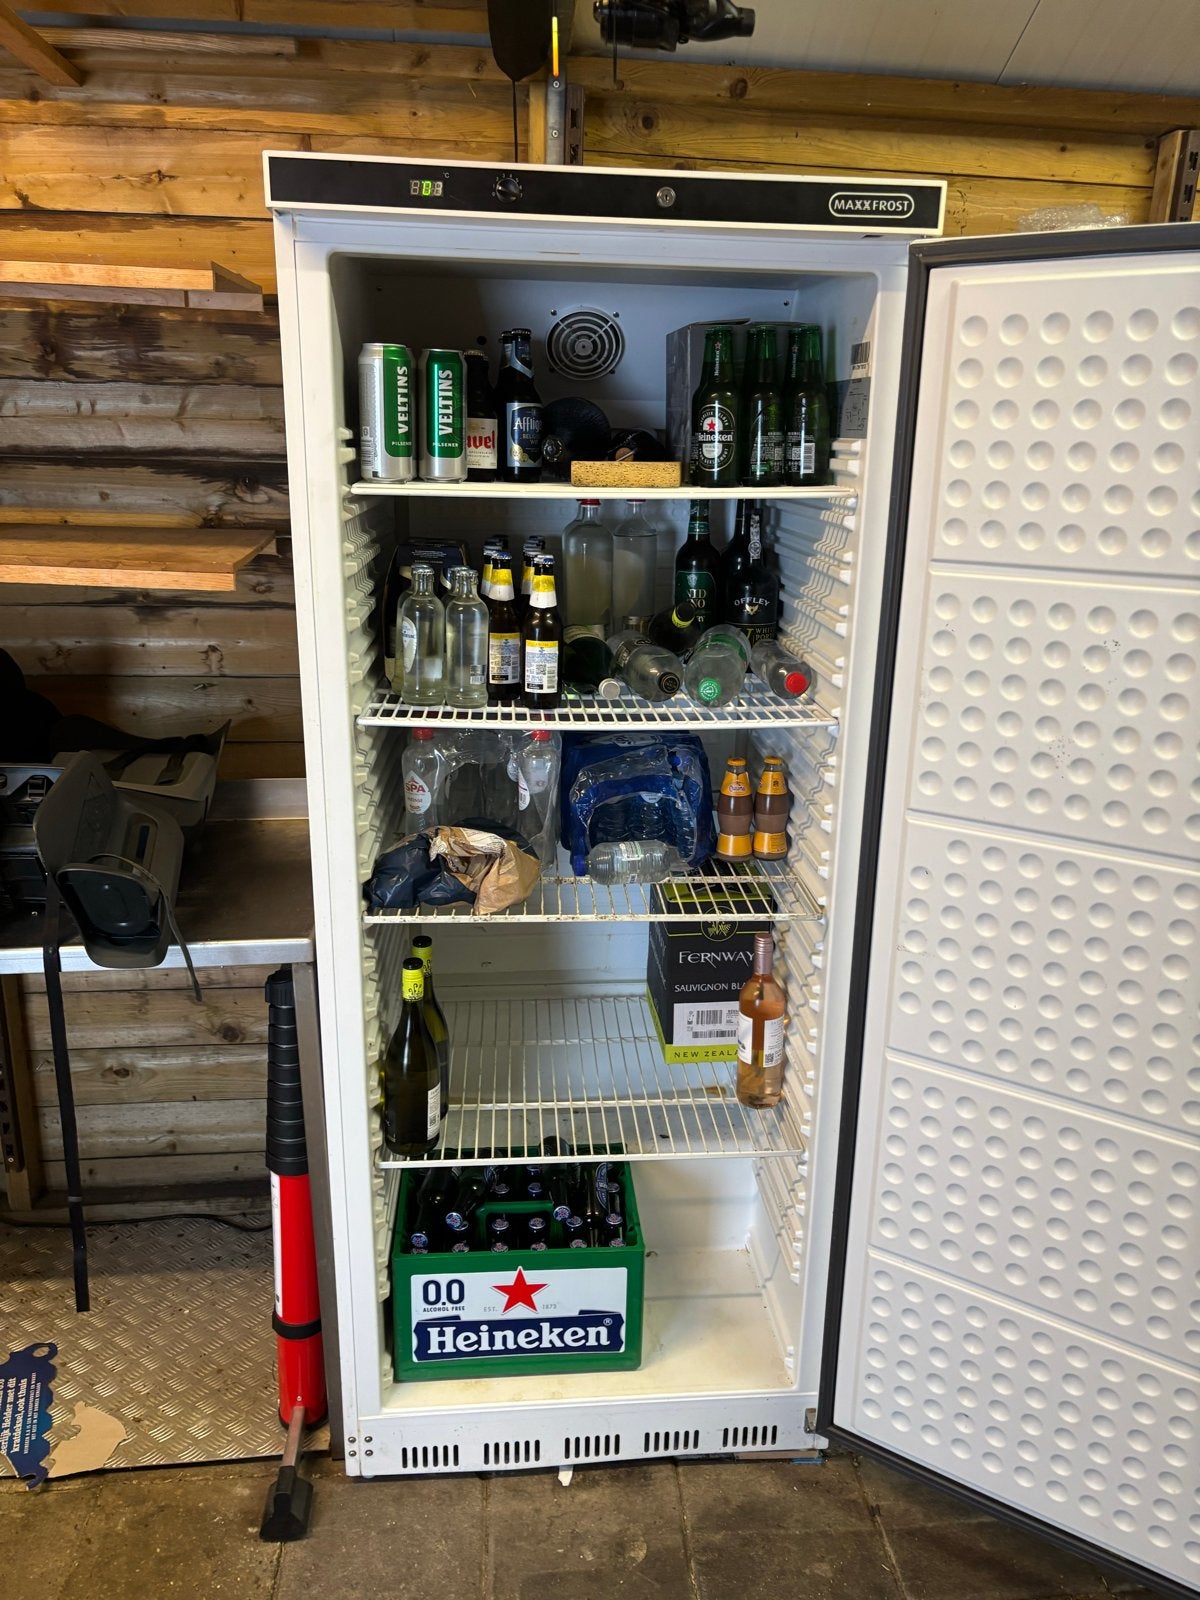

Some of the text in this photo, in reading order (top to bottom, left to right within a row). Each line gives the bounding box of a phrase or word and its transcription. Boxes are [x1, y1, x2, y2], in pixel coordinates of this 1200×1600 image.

[397, 366, 408, 434] VELTINS
[438, 370, 453, 435] VELTINS
[734, 596, 771, 607] OFFLEY
[405, 782, 426, 793] SPA
[679, 951, 754, 968] FERNWAY
[674, 983, 729, 993] SAUVIGNON
[422, 1279, 465, 1306] 0.0
[0, 1429, 11, 1455] eerlijk
